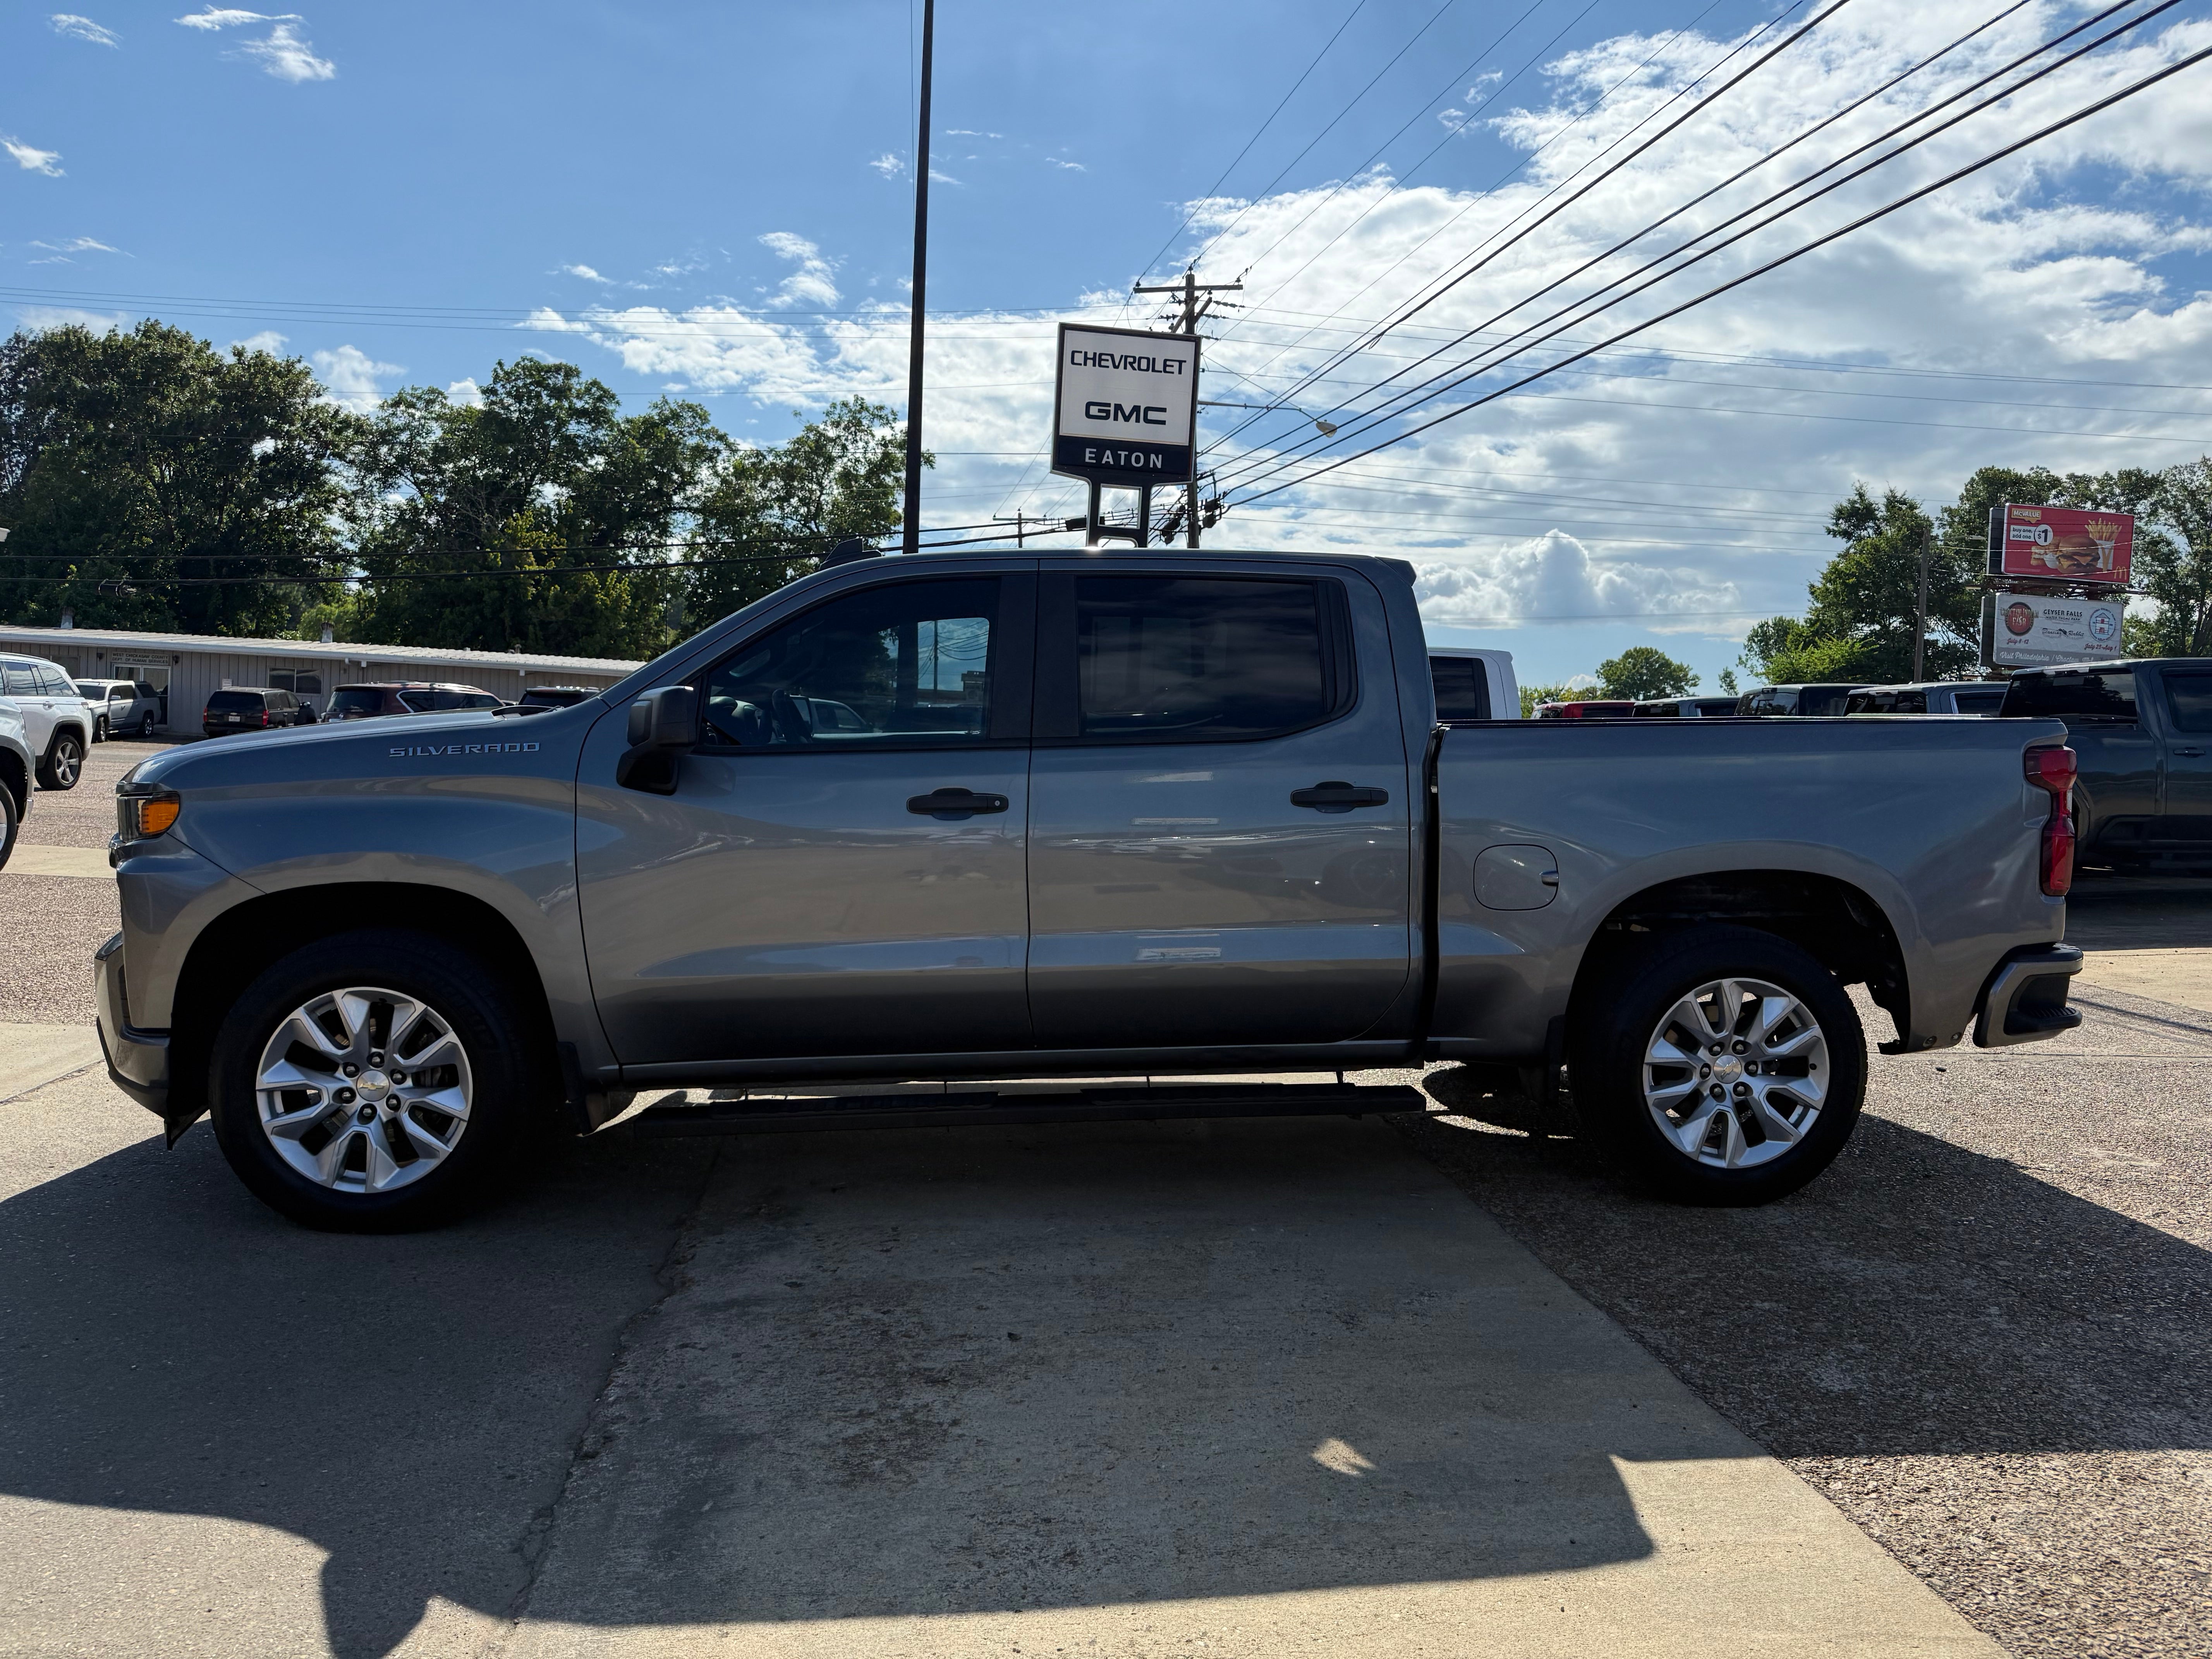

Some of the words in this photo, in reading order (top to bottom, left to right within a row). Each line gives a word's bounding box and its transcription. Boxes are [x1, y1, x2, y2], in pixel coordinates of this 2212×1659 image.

[1071, 350, 1187, 375] CHEVROLET
[1085, 401, 1167, 425] GMC
[1085, 448, 1162, 469] EATON
[2015, 651, 2049, 661] Philadelphia
[389, 742, 540, 757] SILVERADO
